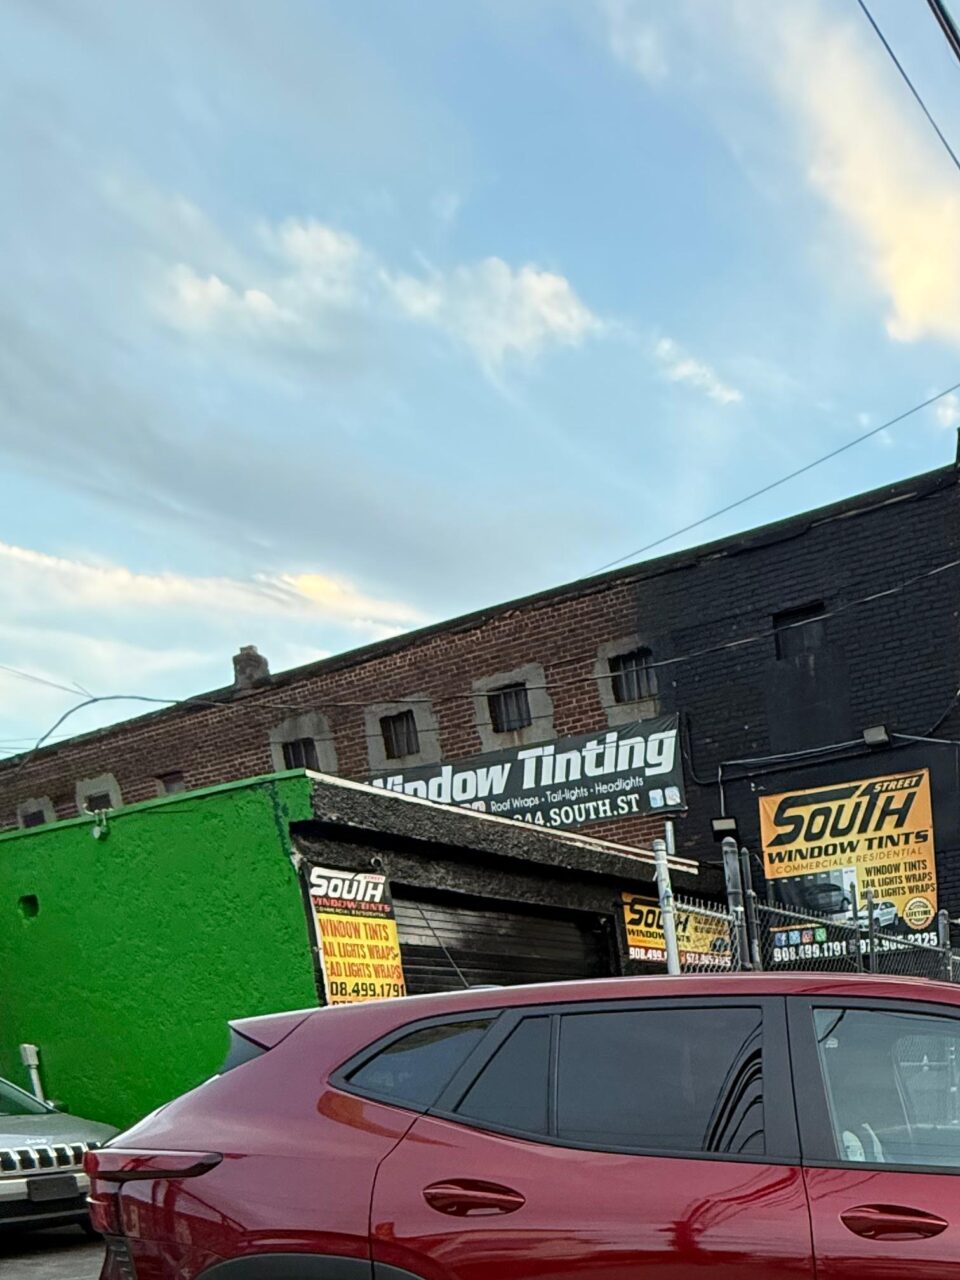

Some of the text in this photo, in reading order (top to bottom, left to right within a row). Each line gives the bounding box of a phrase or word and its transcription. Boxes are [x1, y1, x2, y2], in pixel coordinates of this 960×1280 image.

[517, 729, 677, 790] Tinting
[490, 801, 510, 813] Roof
[512, 796, 539, 810] Wraps
[545, 786, 589, 804] Tail-lights
[594, 776, 644, 794] Headlights
[873, 776, 919, 793] STREET
[766, 775, 923, 847] SOUTH
[767, 829, 928, 865] WINDOW TINTS
[775, 858, 843, 875] COMMERCIAL
[856, 847, 923, 865] RESIDENTIAL
[865, 859, 928, 877] WINDOW TINTS
[310, 867, 386, 903] SOUTH
[878, 875, 903, 888] LIGHTS
[905, 871, 933, 884] WRAPS
[881, 886, 907, 899] LIGHTS
[908, 882, 936, 895] WRAPS
[319, 918, 390, 941] WINDOW TINTS
[338, 942, 367, 960] LIGHTS
[367, 944, 396, 961] WRAPS
[342, 962, 373, 979] LIGHTS
[372, 963, 402, 980] WRAPS
[329, 981, 405, 998] 08.499.1791
